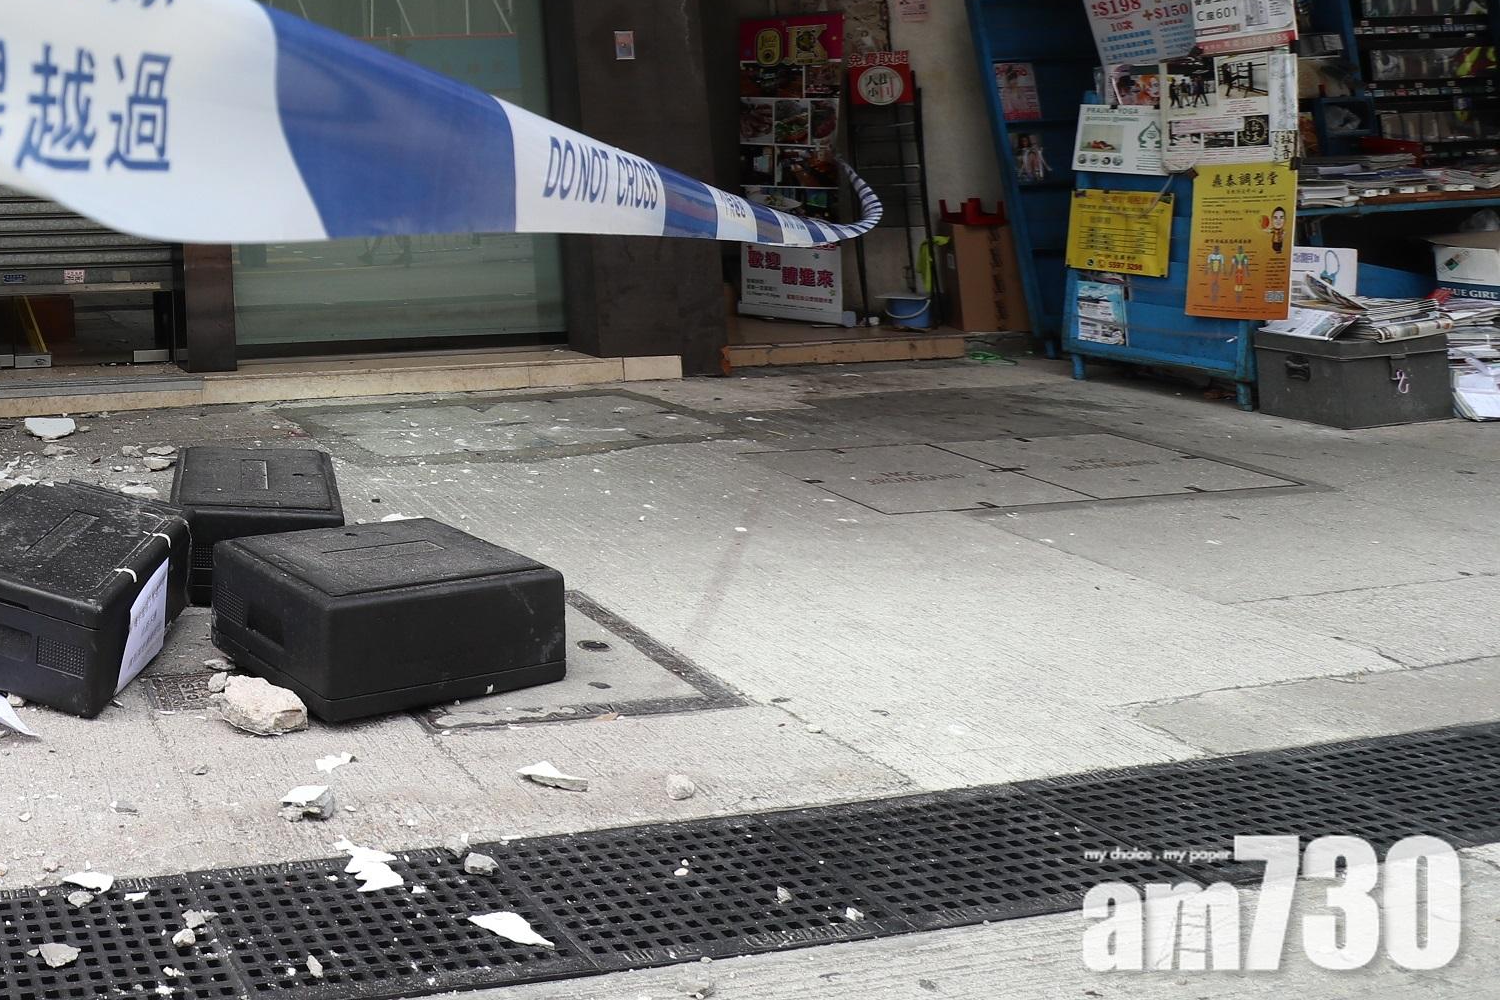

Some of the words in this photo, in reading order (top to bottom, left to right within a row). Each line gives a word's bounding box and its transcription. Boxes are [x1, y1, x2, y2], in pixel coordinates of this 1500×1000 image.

[542, 135, 576, 200] DO
[575, 145, 610, 204] NOT
[615, 147, 659, 211] CROSS
